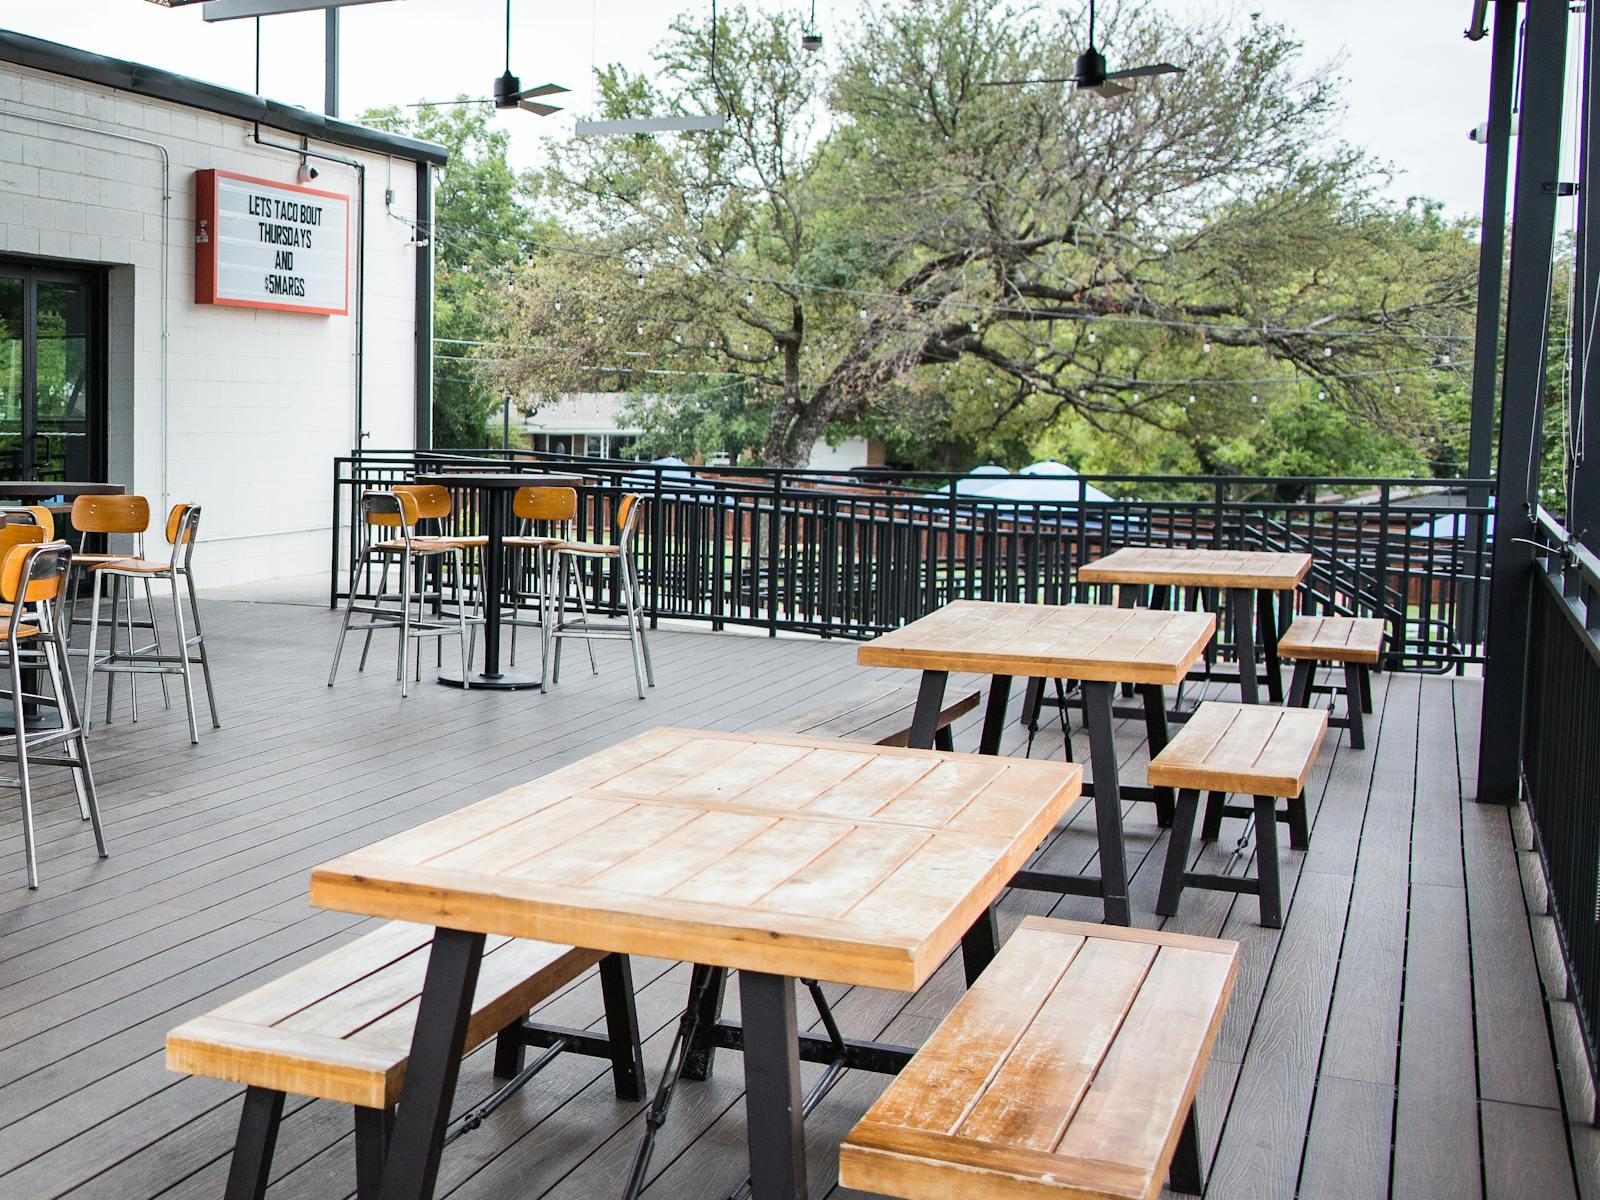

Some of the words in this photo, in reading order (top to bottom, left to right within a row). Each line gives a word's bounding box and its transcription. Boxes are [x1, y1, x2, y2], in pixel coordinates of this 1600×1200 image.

[249, 195, 272, 218] LETS
[275, 200, 298, 223] TACO
[301, 205, 323, 226] BOUT
[259, 222, 312, 249] THURSDAYS
[275, 250, 293, 271] AND
